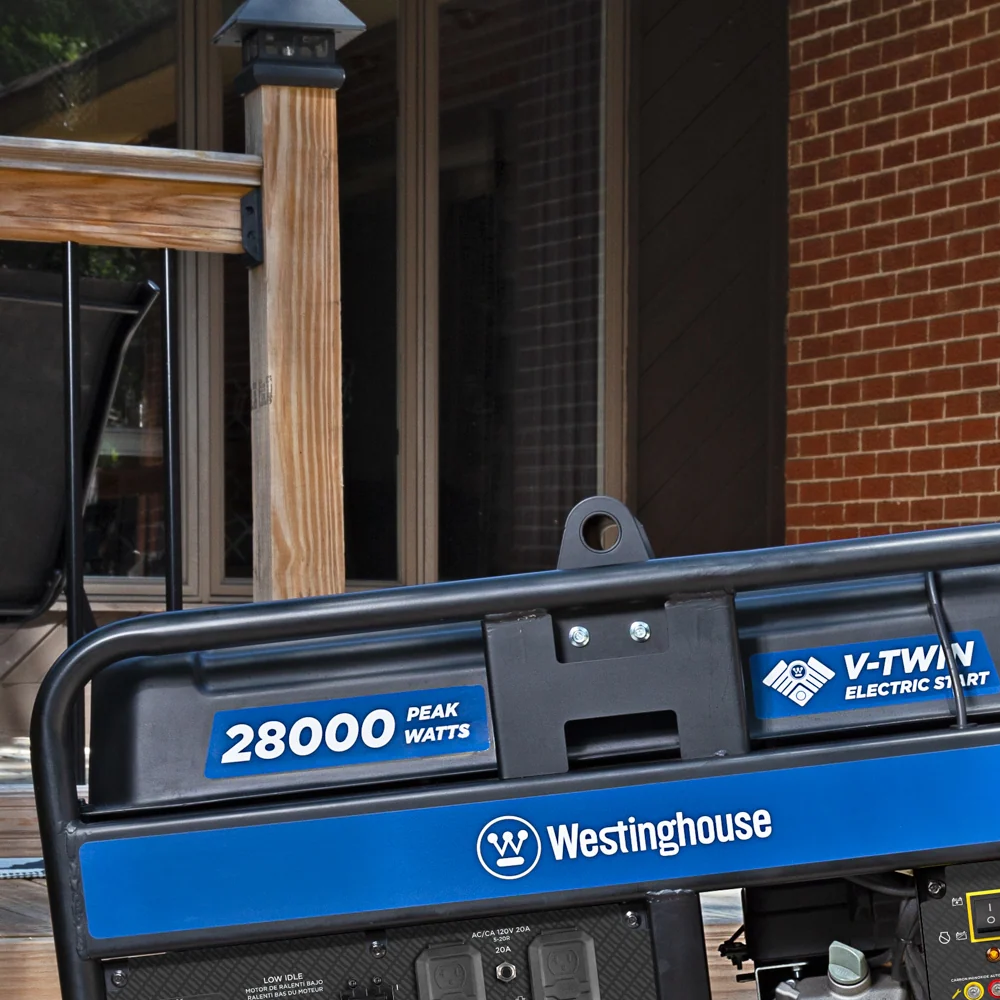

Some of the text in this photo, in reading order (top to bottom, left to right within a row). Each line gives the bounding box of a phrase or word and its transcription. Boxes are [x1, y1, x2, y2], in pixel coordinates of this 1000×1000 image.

[844, 641, 974, 680] V-TWIN
[845, 678, 932, 700] ELECTRIC
[406, 702, 459, 721] PEAK
[220, 708, 396, 764] 28000
[404, 723, 470, 744] WATTS
[547, 808, 772, 860] Westinghouse
[472, 930, 495, 938] AC/CA
[264, 973, 303, 984] LOW IDLE
